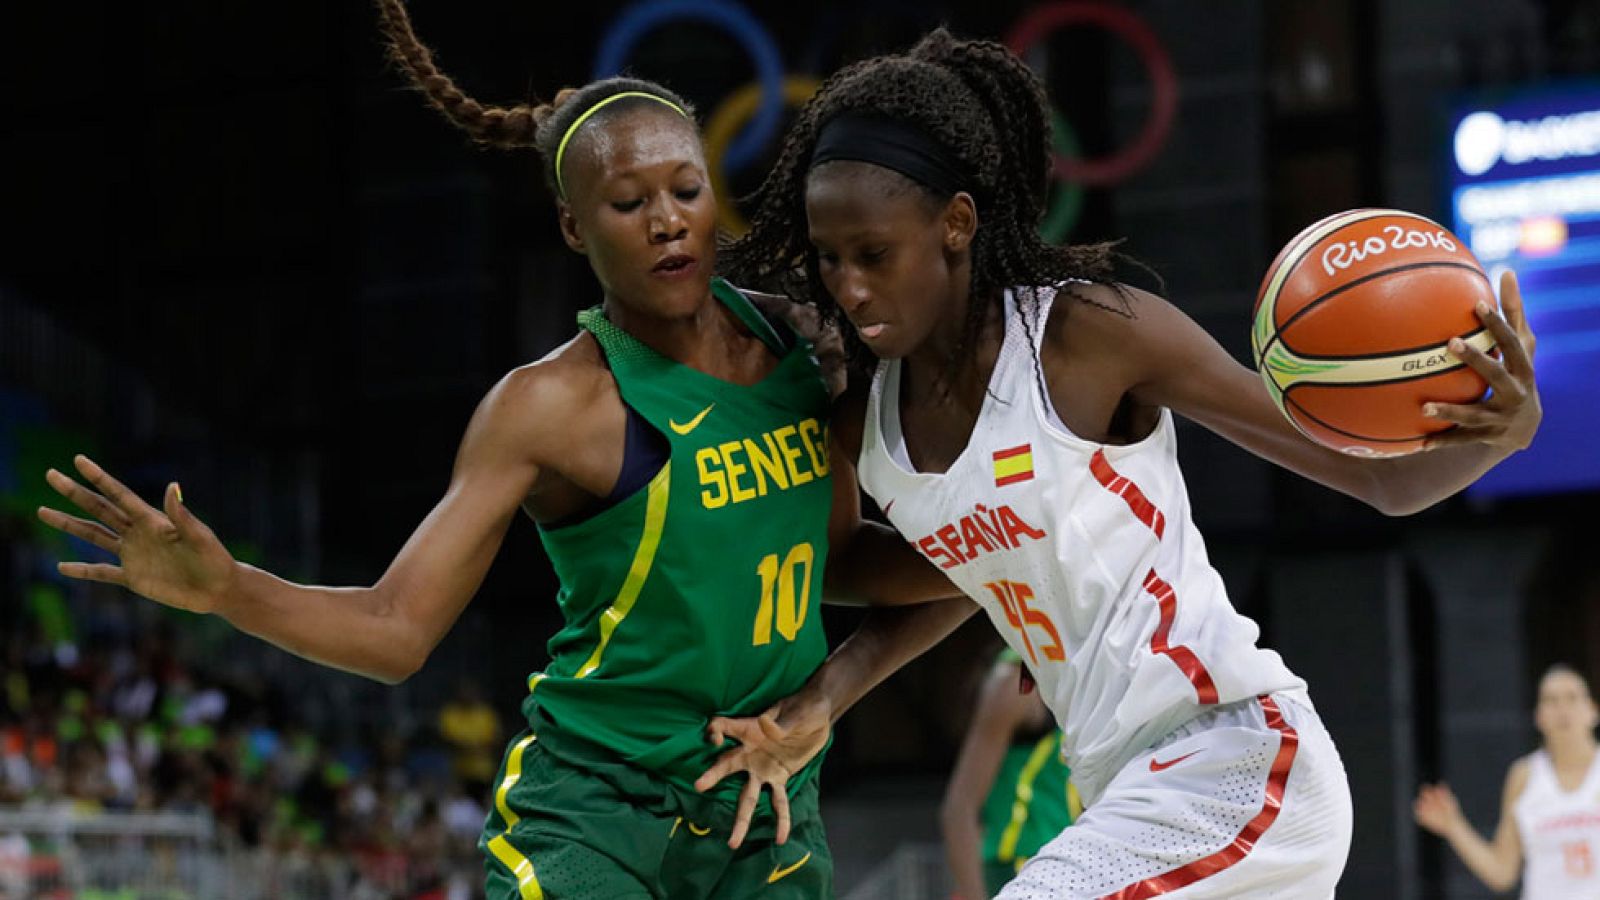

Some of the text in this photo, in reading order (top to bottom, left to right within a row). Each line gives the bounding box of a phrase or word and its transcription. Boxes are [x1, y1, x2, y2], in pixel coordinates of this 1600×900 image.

[1322, 236, 1386, 276] Rio
[1383, 226, 1456, 252] 2016
[695, 418, 830, 509] SENEG
[911, 503, 1047, 569] SPAÑA
[753, 543, 814, 646] 10
[983, 579, 1066, 667] 45
